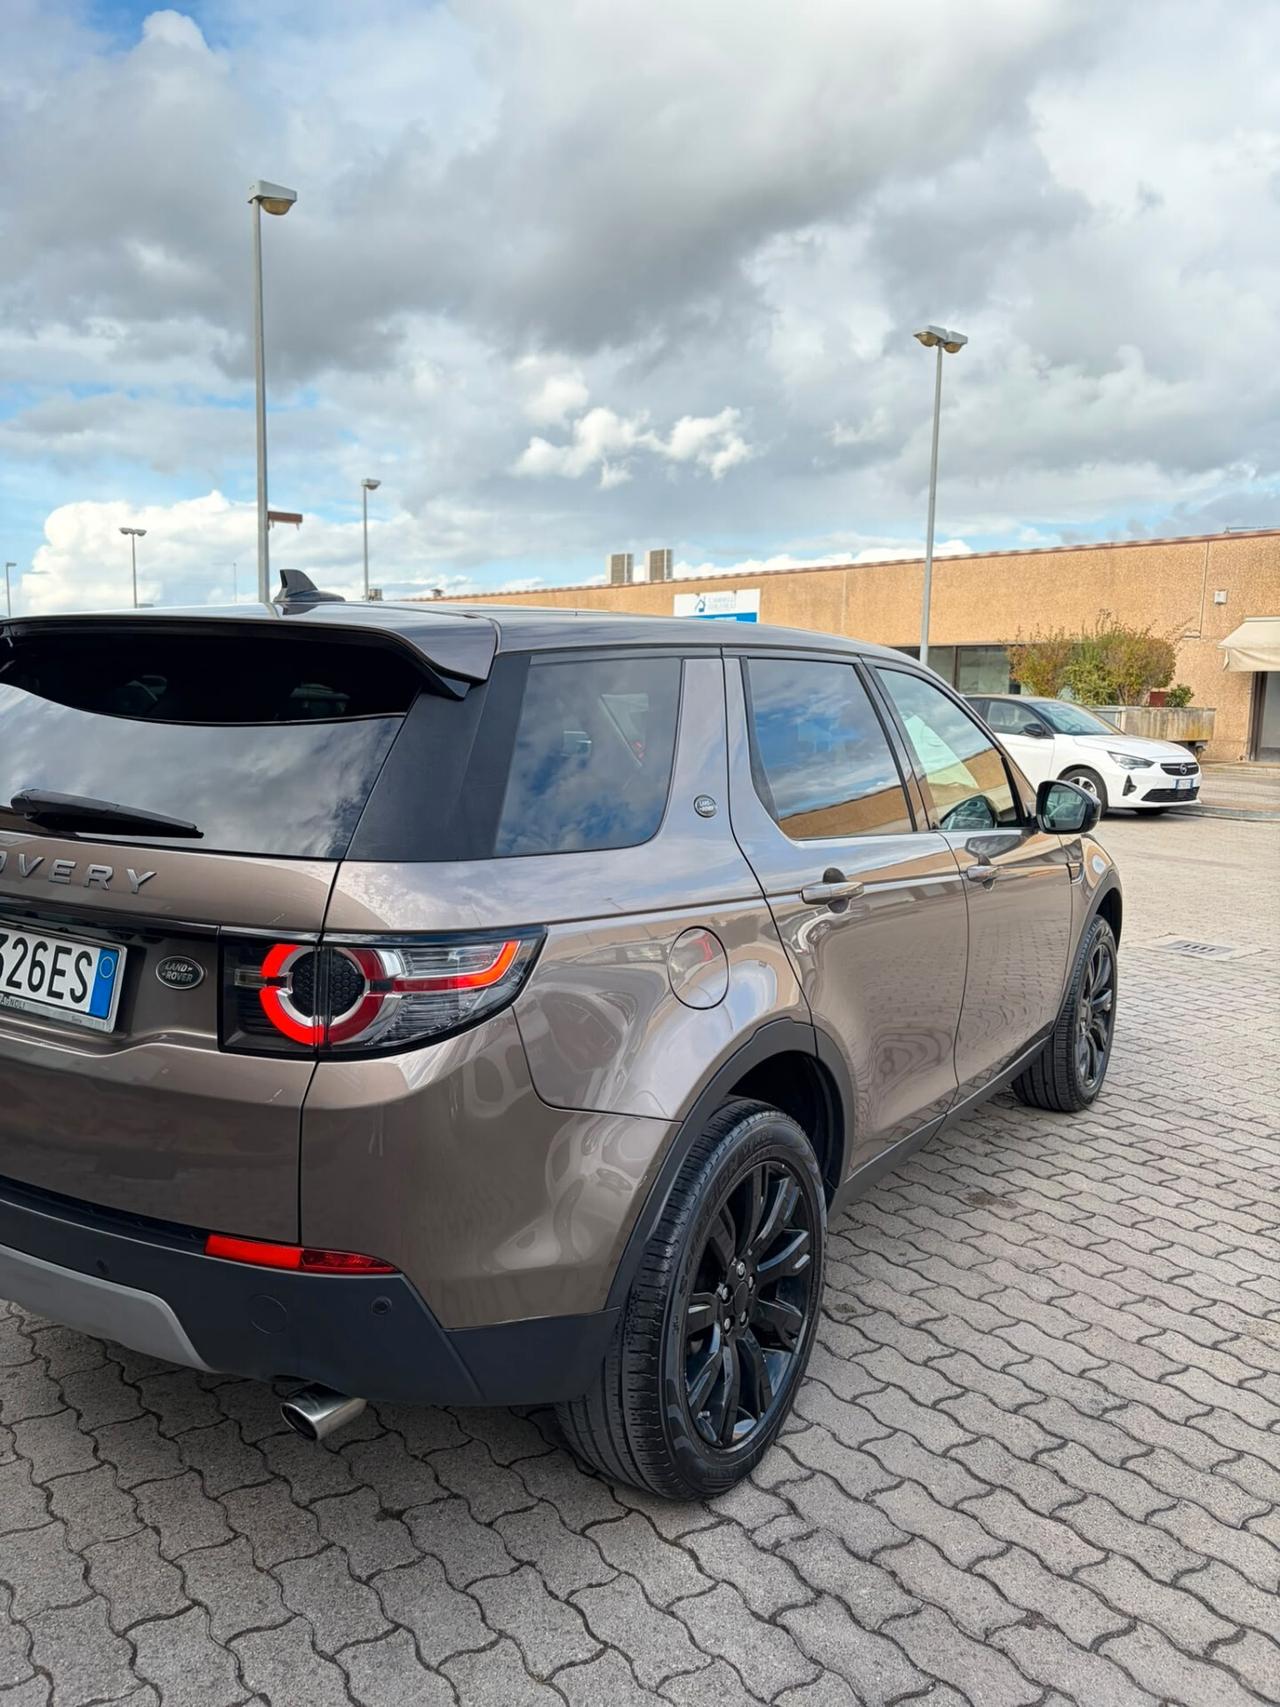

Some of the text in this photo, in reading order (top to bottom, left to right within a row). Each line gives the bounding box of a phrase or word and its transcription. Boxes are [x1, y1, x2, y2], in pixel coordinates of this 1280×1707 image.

[0, 851, 157, 894] VERY
[165, 961, 188, 972] LAND
[166, 970, 194, 983] ROVER
